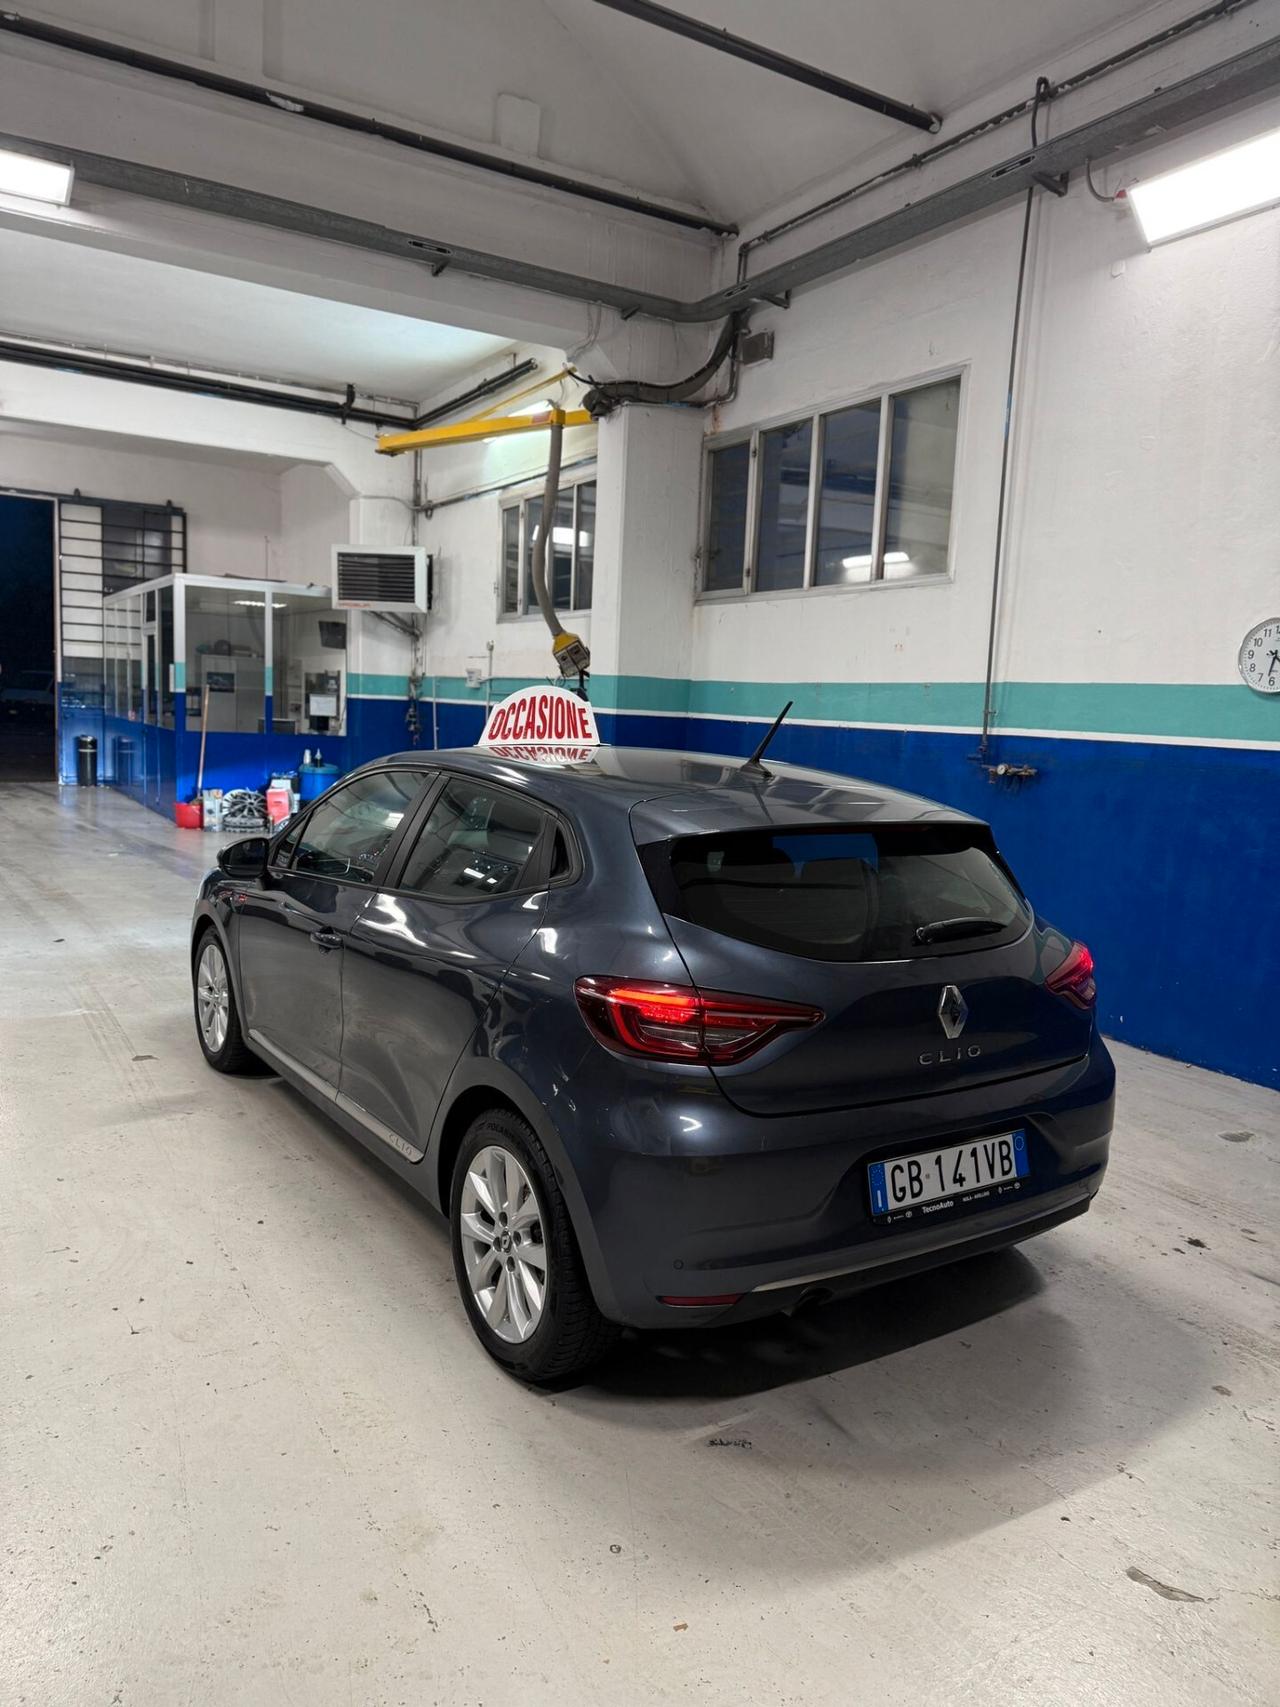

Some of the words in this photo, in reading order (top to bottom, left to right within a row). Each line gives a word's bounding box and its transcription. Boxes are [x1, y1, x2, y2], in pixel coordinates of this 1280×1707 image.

[1264, 628, 1272, 637] 11
[1253, 637, 1263, 647] 10
[1247, 649, 1255, 659] 9
[1249, 663, 1256, 672] 8
[1257, 673, 1264, 682] 7
[1268, 676, 1275, 686] 6
[487, 694, 592, 740] OCCASIONE
[919, 1044, 981, 1065] CLIO
[389, 1133, 412, 1156] CLIO
[921, 1200, 954, 1214] TecnoAuto
